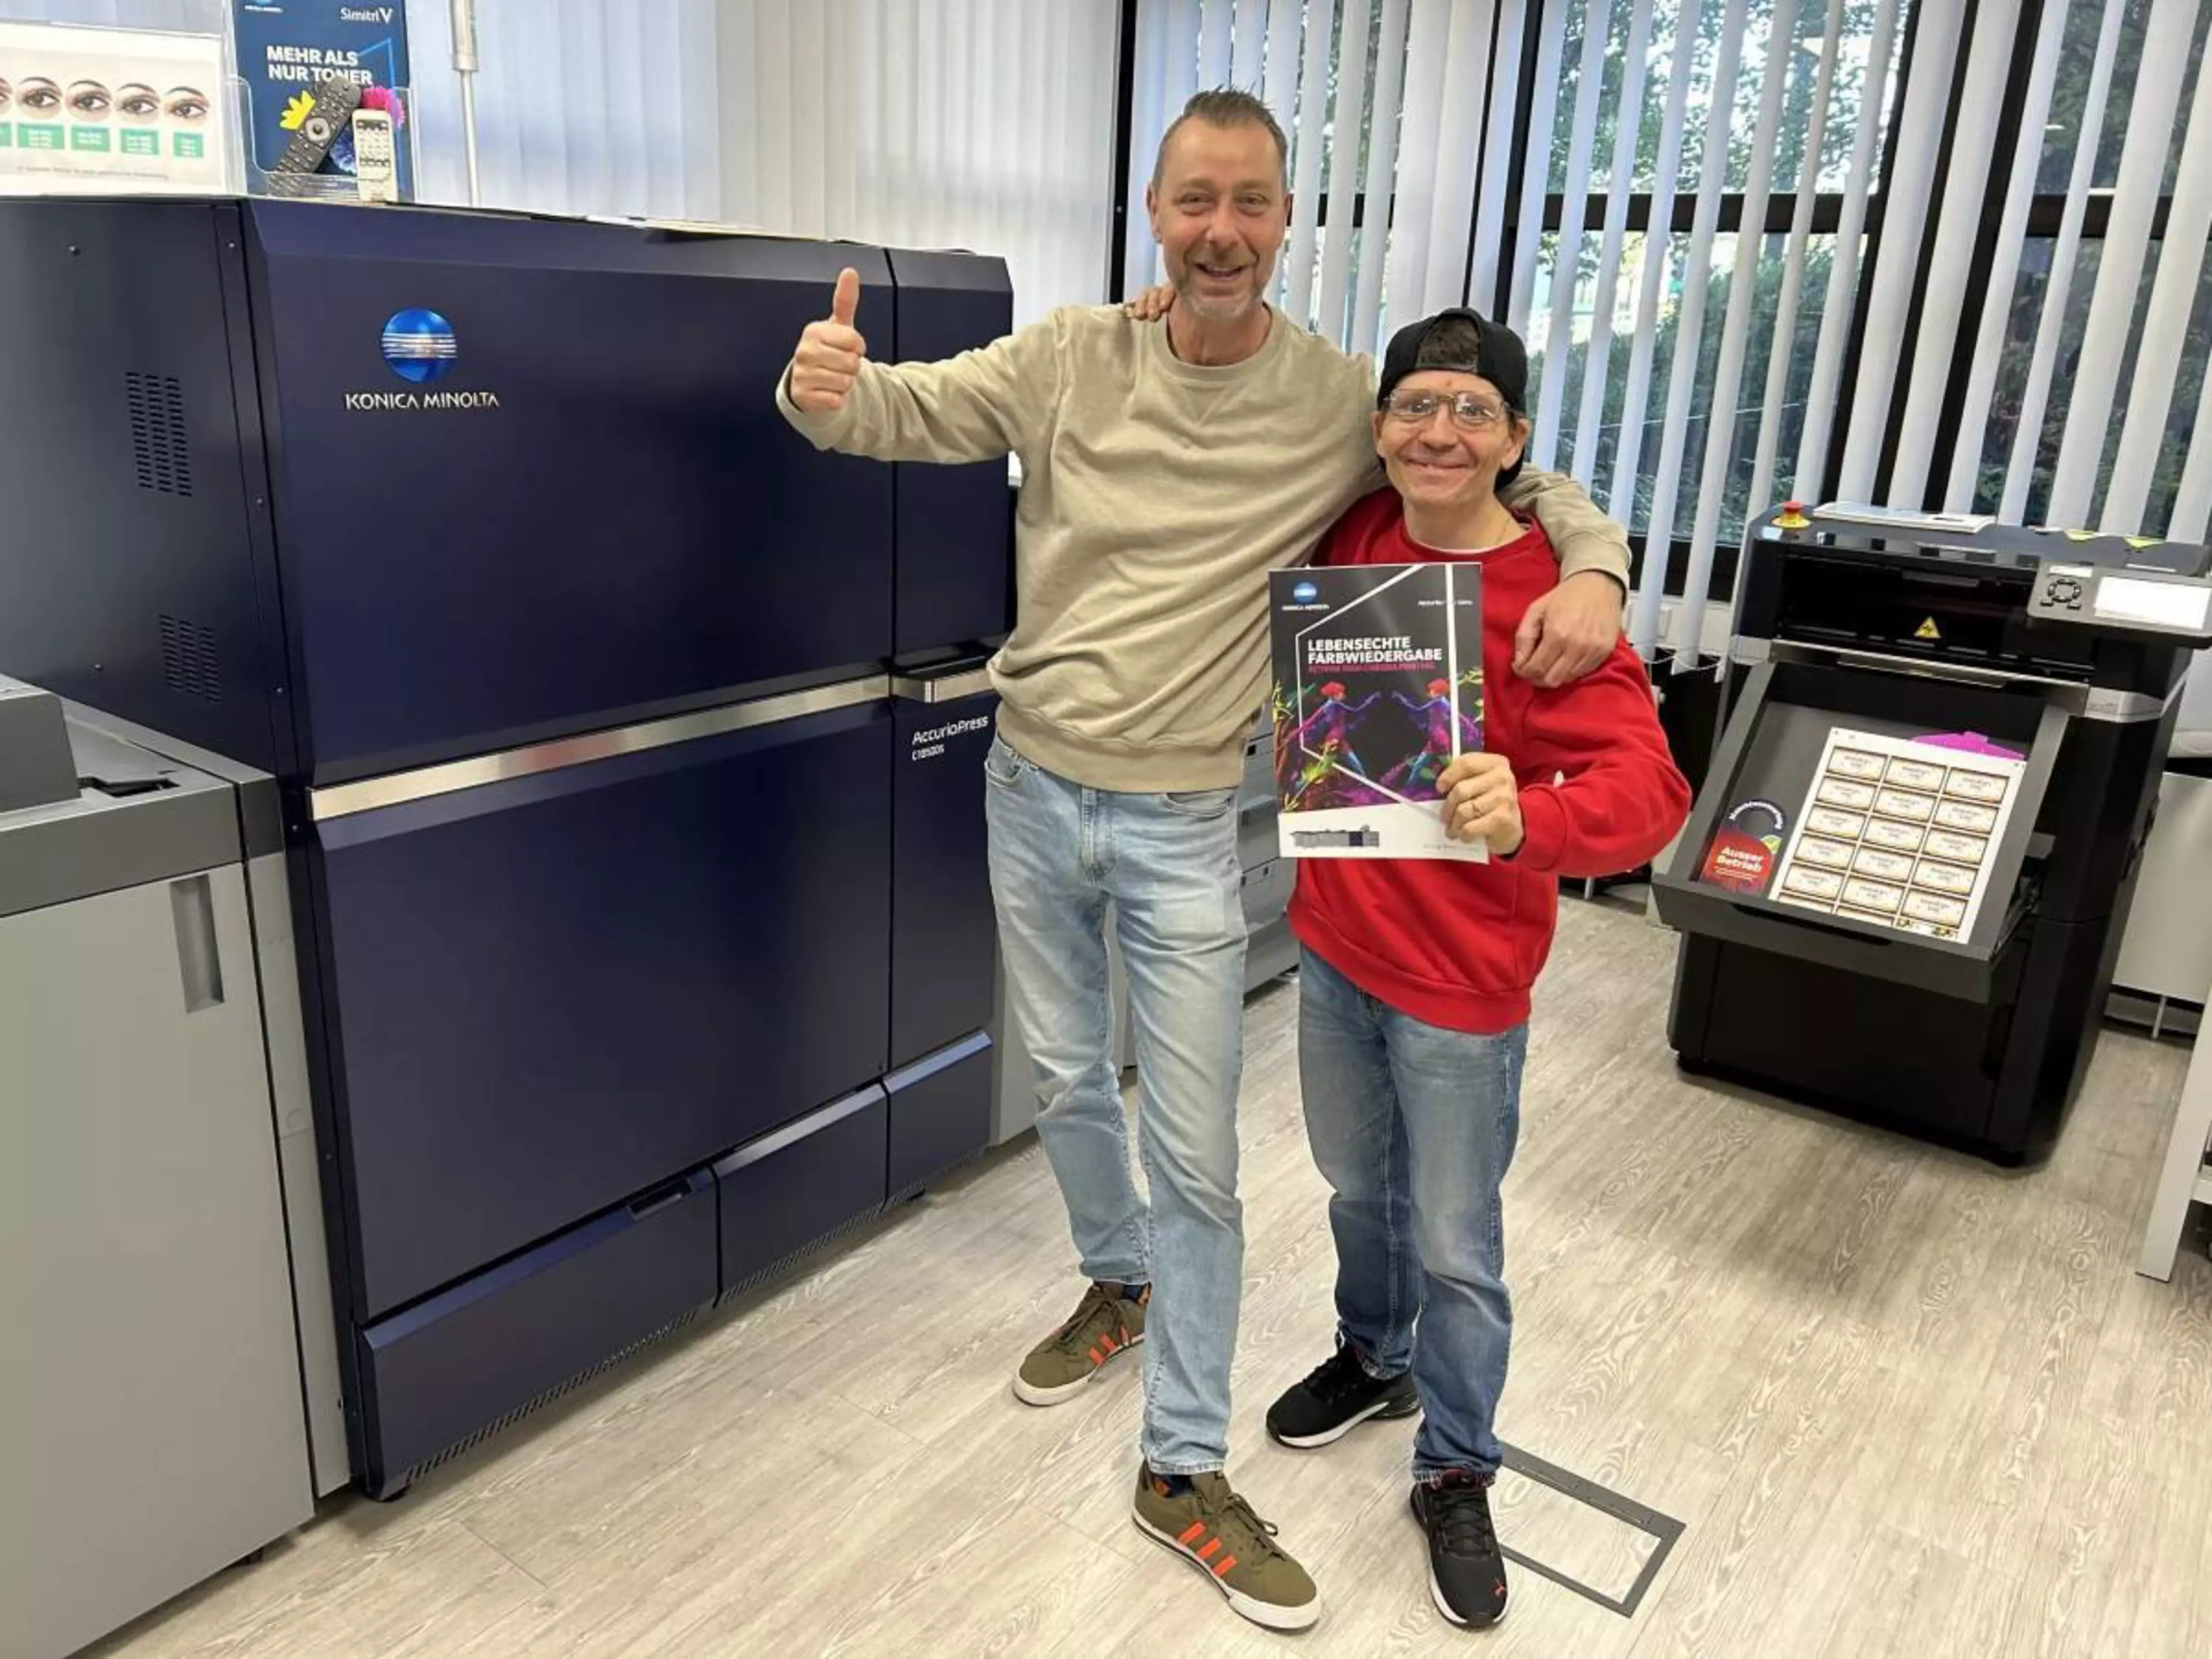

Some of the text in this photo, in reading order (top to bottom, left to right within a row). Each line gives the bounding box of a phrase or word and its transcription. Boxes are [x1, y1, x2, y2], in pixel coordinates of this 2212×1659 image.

[266, 46, 358, 66] MEHR ALS
[268, 64, 373, 85] NUR TONER
[346, 392, 501, 410] KONICA MINOLTA
[1308, 636, 1411, 652] LEBENSECHTE
[1308, 649, 1442, 665] FARBWIEDERGABE
[912, 715, 988, 745] AccurioPress
